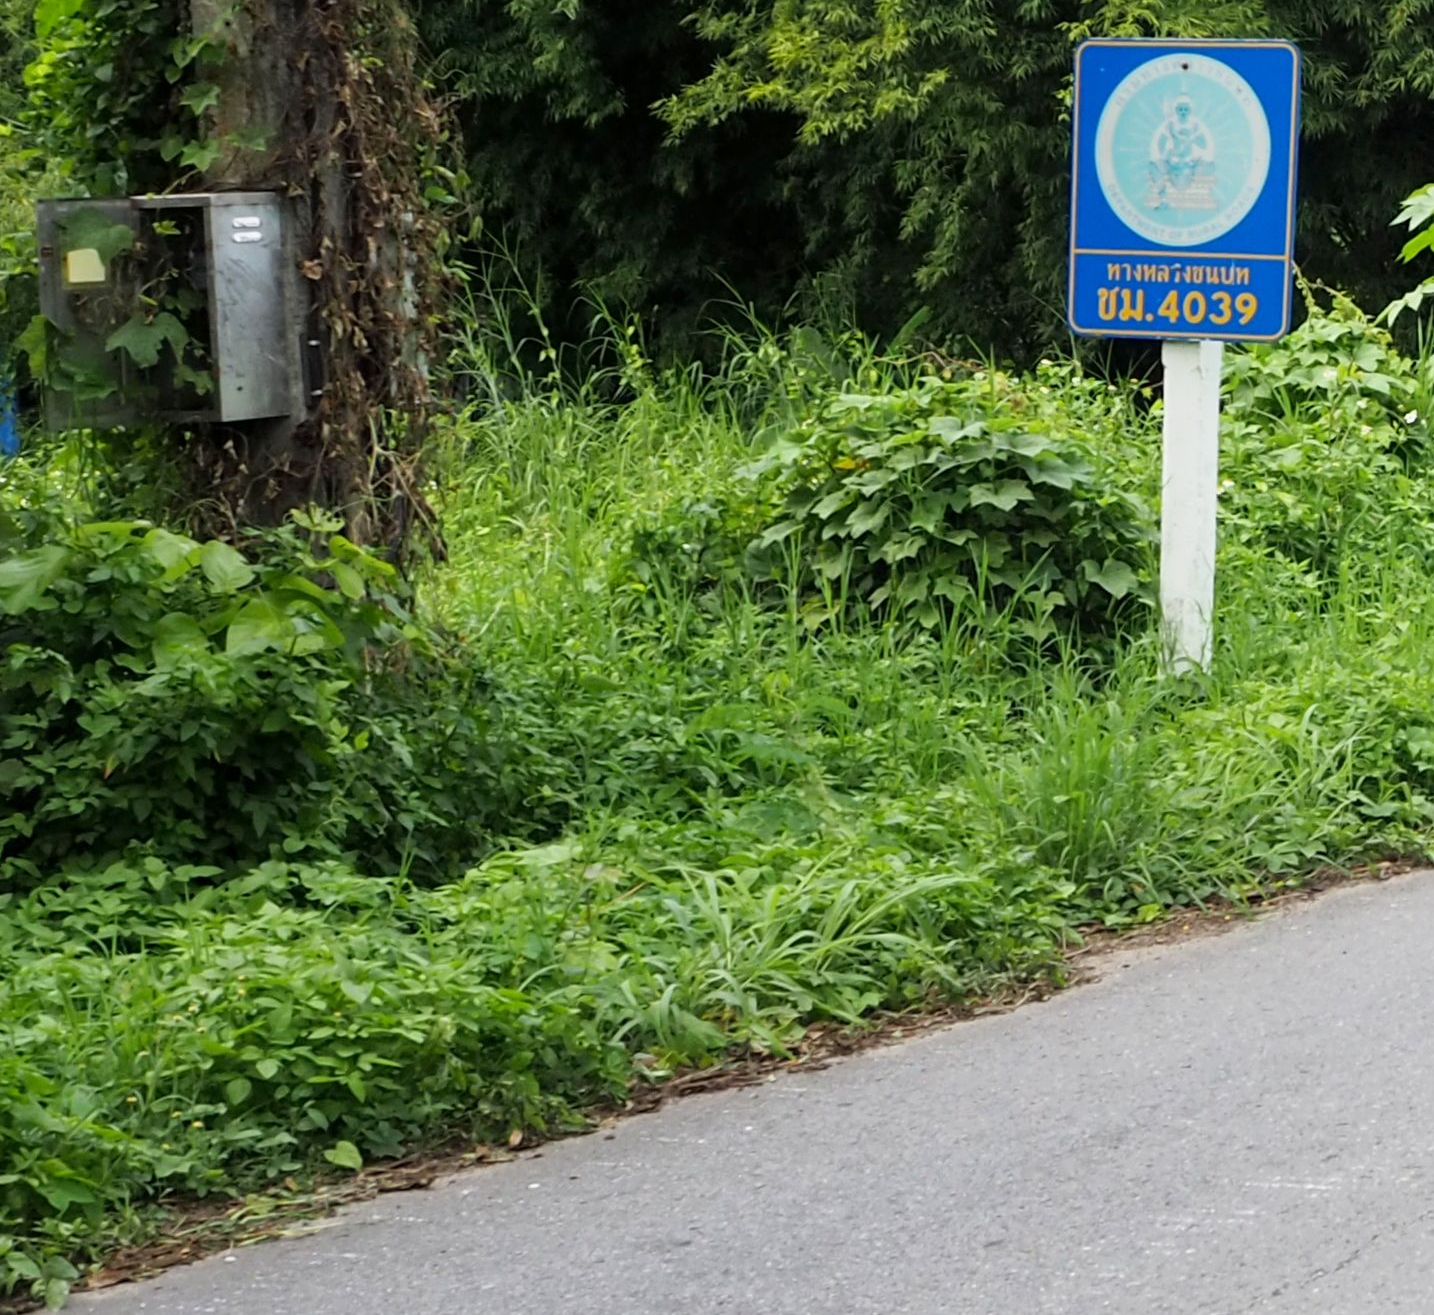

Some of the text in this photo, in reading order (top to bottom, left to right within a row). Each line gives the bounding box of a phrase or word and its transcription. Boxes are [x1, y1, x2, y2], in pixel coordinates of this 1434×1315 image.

[1107, 262, 1250, 286] ทางหลวงชนบท
